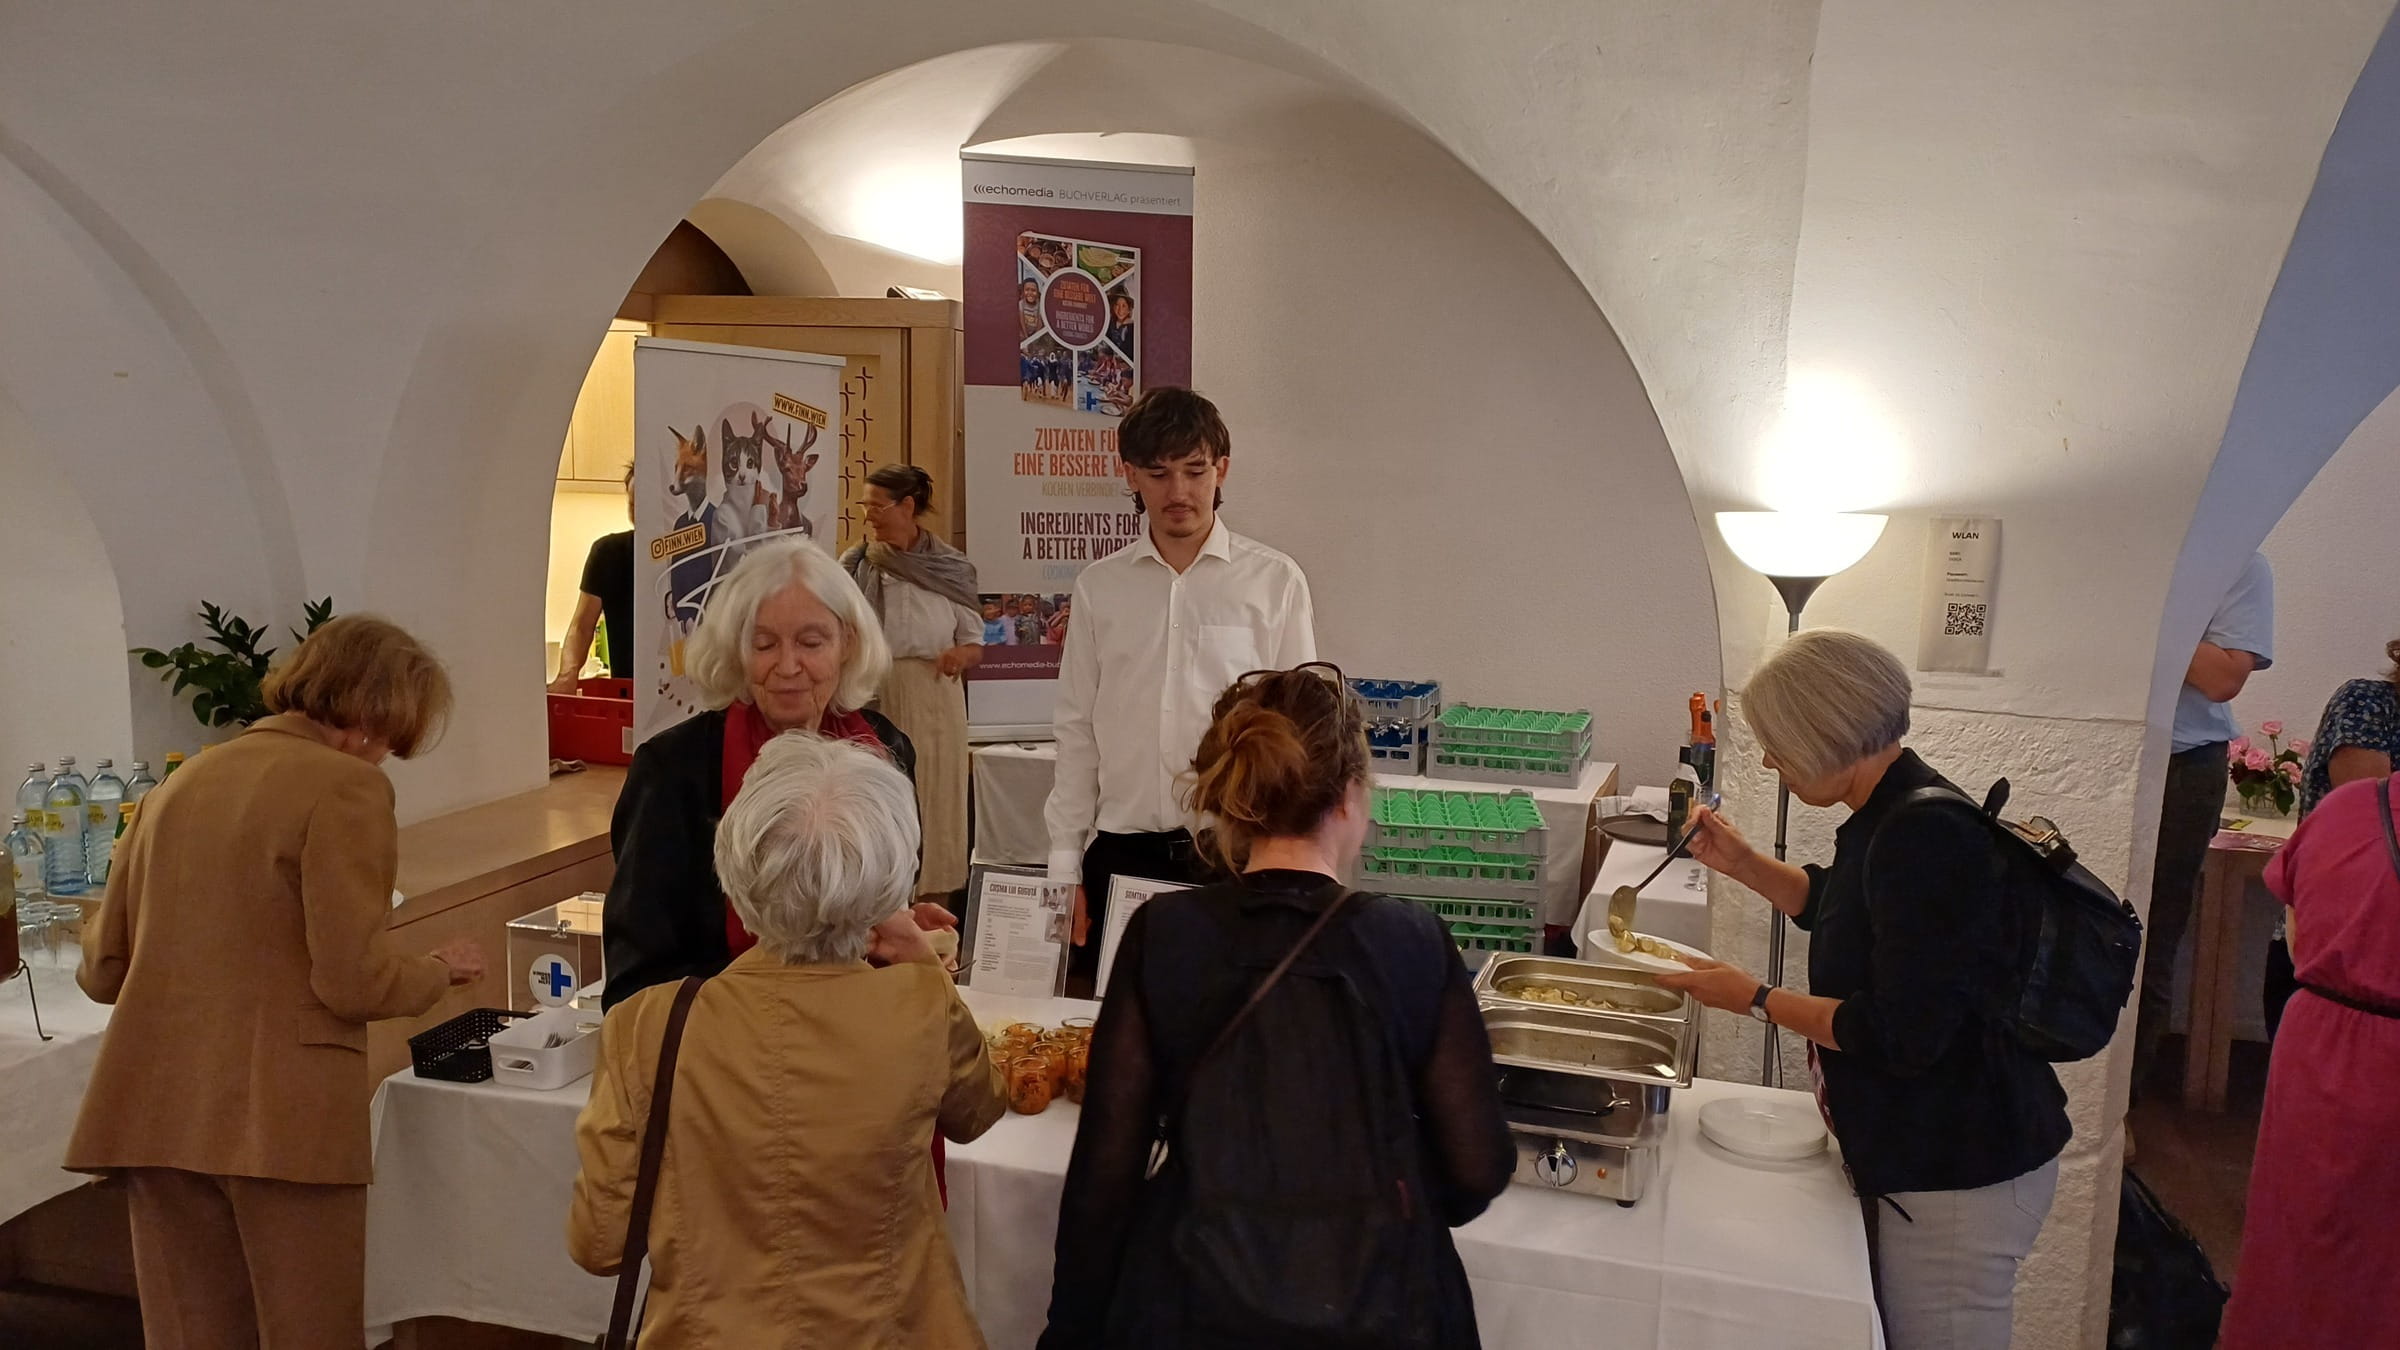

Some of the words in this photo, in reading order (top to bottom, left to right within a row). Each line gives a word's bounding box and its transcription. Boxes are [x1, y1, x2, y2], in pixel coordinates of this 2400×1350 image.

[986, 184, 1054, 198] echomedia
[1059, 189, 1128, 203] BUCHVERLAG
[774, 396, 827, 426] WWW.FINN.WIEN
[1035, 428, 1096, 452] ZUTATEN
[1014, 453, 1045, 476] EINE
[1050, 454, 1108, 477] BESSERE
[1042, 481, 1074, 497] KOCHEN
[1021, 511, 1111, 535] INGREDIENTS
[1116, 513, 1141, 535] FOR
[664, 528, 704, 553] FINN.WIEN
[1952, 532, 1979, 540] WLAN
[1023, 537, 1033, 560] A
[1037, 537, 1087, 560] BETTER
